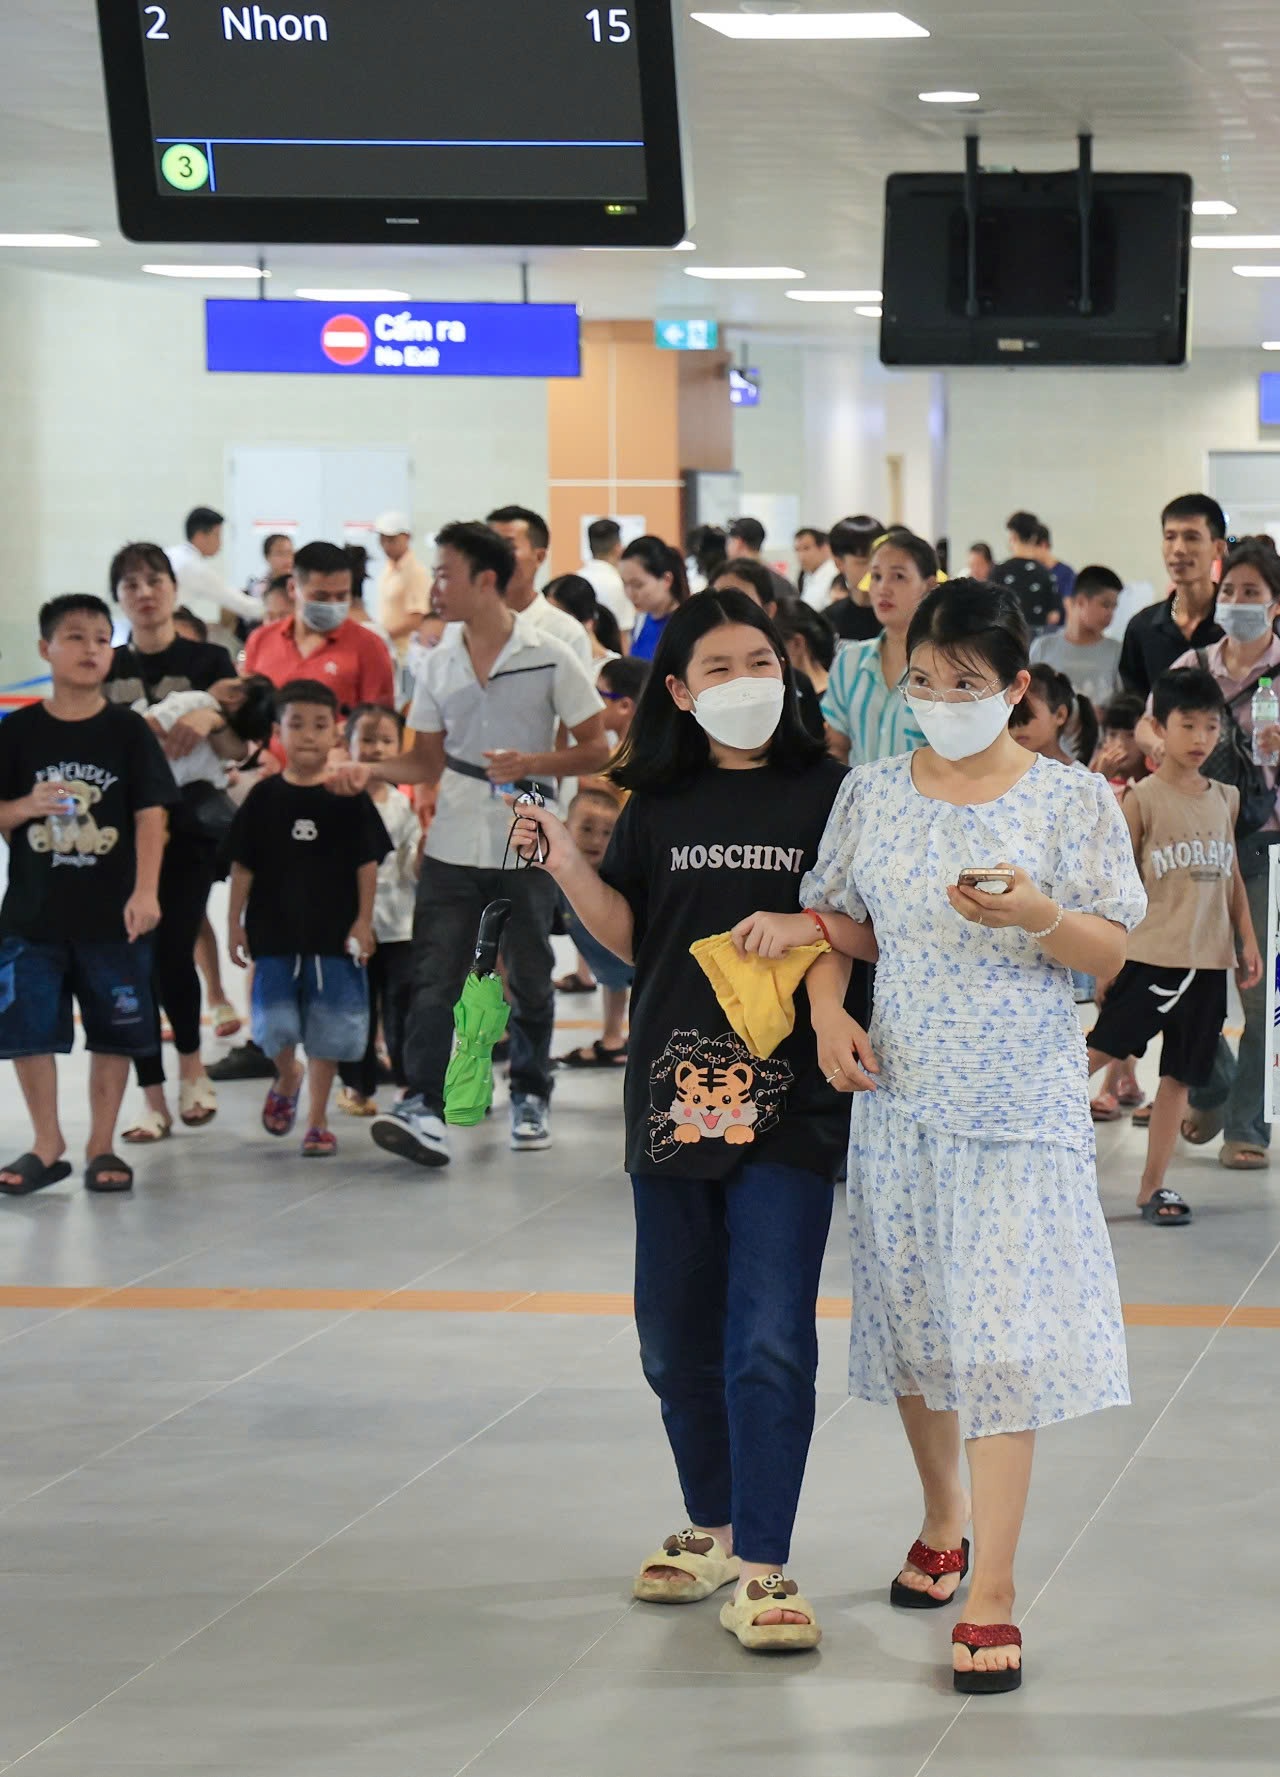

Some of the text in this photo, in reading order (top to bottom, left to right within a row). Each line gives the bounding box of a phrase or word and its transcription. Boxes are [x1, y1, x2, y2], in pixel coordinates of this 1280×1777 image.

[144, 5, 631, 43] 2 Nhon 15
[179, 156, 193, 178] 3
[375, 311, 466, 342] Cấm ra
[404, 345, 440, 367] Exit
